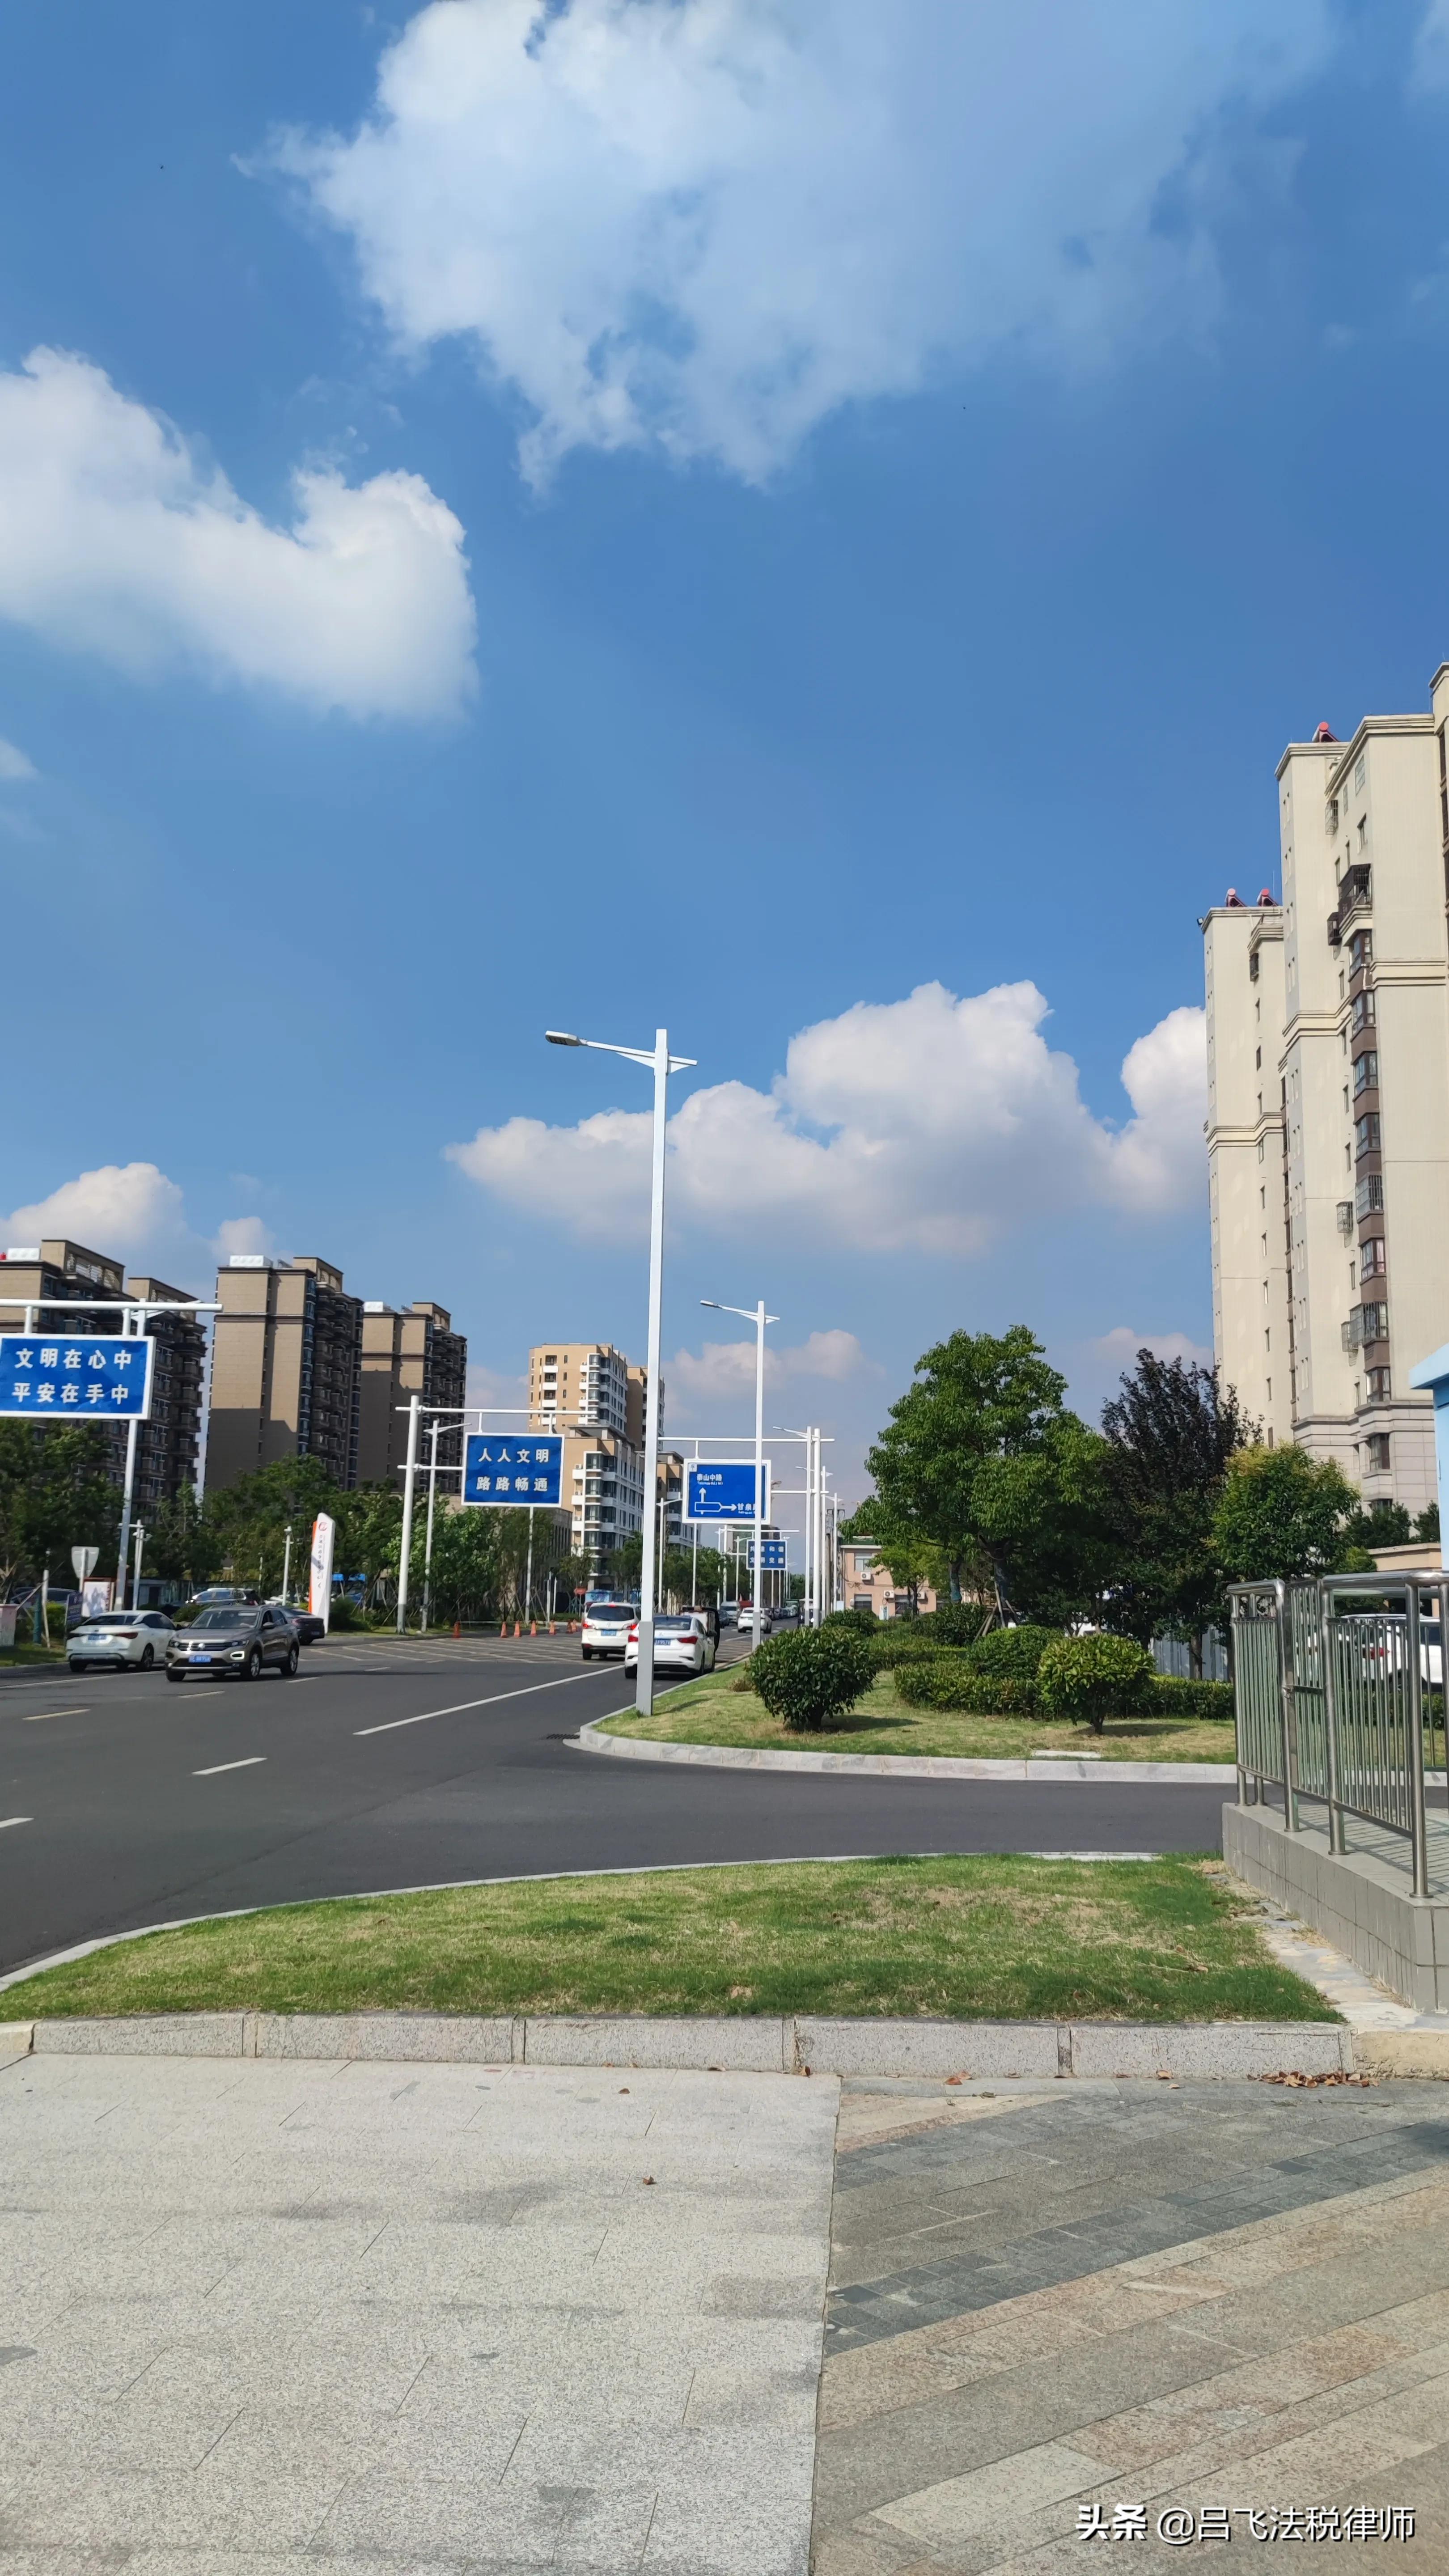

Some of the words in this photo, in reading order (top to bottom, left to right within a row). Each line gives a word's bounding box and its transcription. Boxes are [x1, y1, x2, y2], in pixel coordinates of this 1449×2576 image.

[14, 1347, 131, 1370] 文明在心中
[12, 1382, 128, 1405] 平安在手中
[478, 1448, 549, 1463] 人人文明
[476, 1476, 547, 1491] 路路畅通
